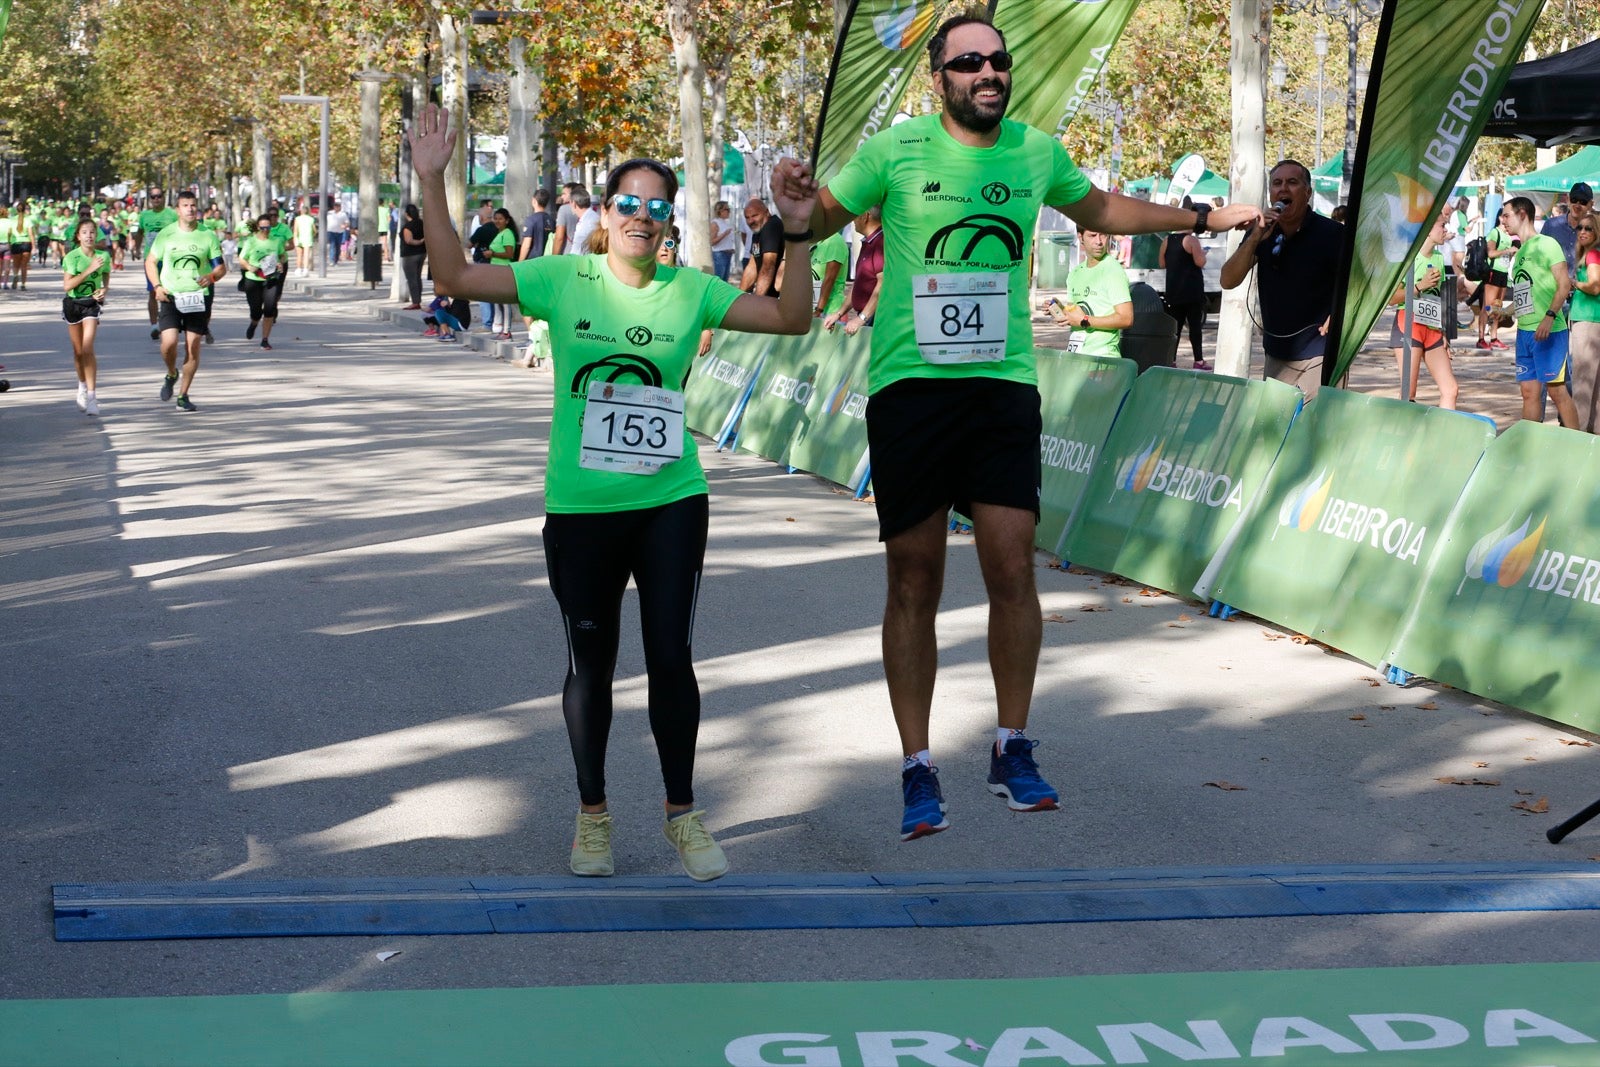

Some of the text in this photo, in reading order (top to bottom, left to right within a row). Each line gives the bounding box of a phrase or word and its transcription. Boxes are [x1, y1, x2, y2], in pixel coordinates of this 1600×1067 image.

[925, 194, 973, 204] IBERDROLA
[936, 259, 962, 267] FORMA
[1418, 302, 1438, 318] 566
[940, 303, 984, 337] 84
[575, 332, 617, 344] IBERDROLA
[601, 411, 667, 449] 153
[724, 1008, 1598, 1067] GRANADA
